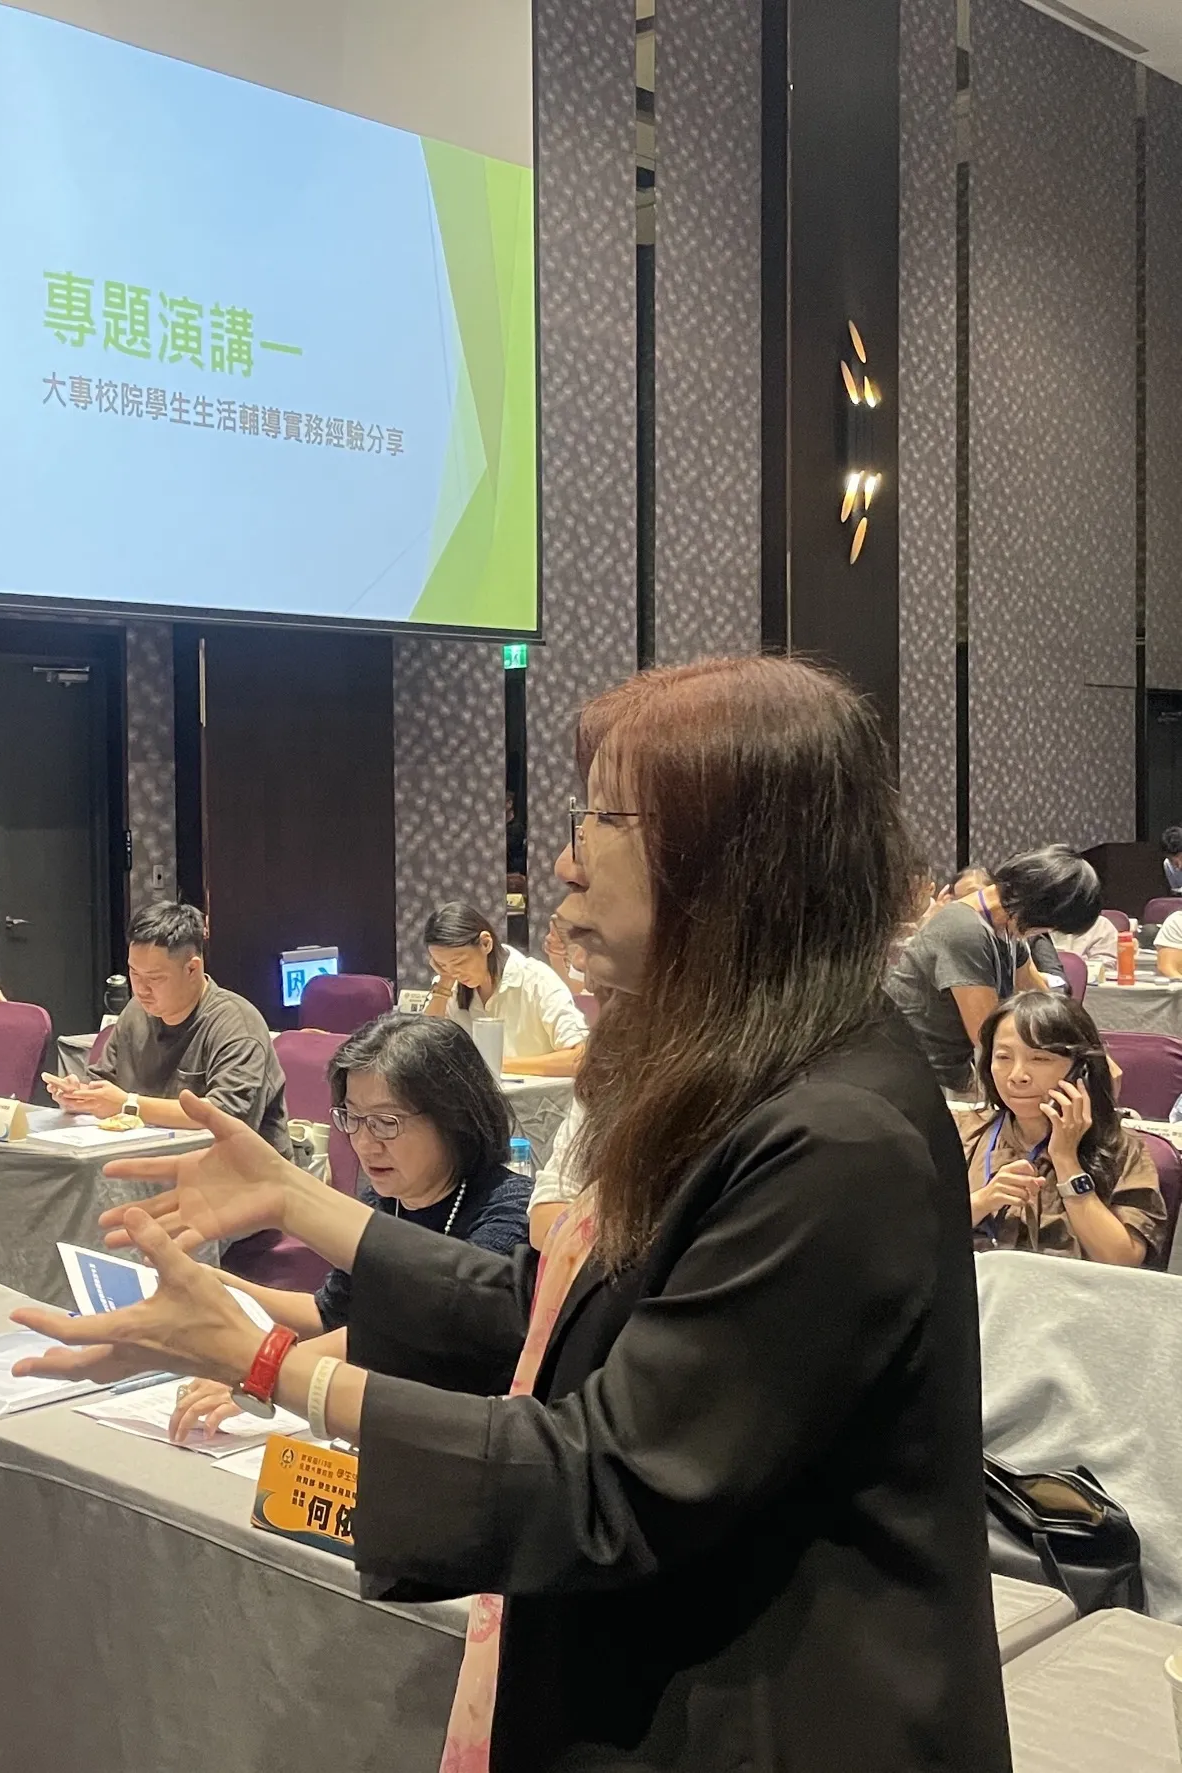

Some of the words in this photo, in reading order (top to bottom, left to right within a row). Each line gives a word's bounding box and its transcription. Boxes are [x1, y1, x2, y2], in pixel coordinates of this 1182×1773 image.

[43, 270, 303, 378] 專題演講一
[42, 371, 405, 456] 大專校院學生生活輔導實務經驗分享
